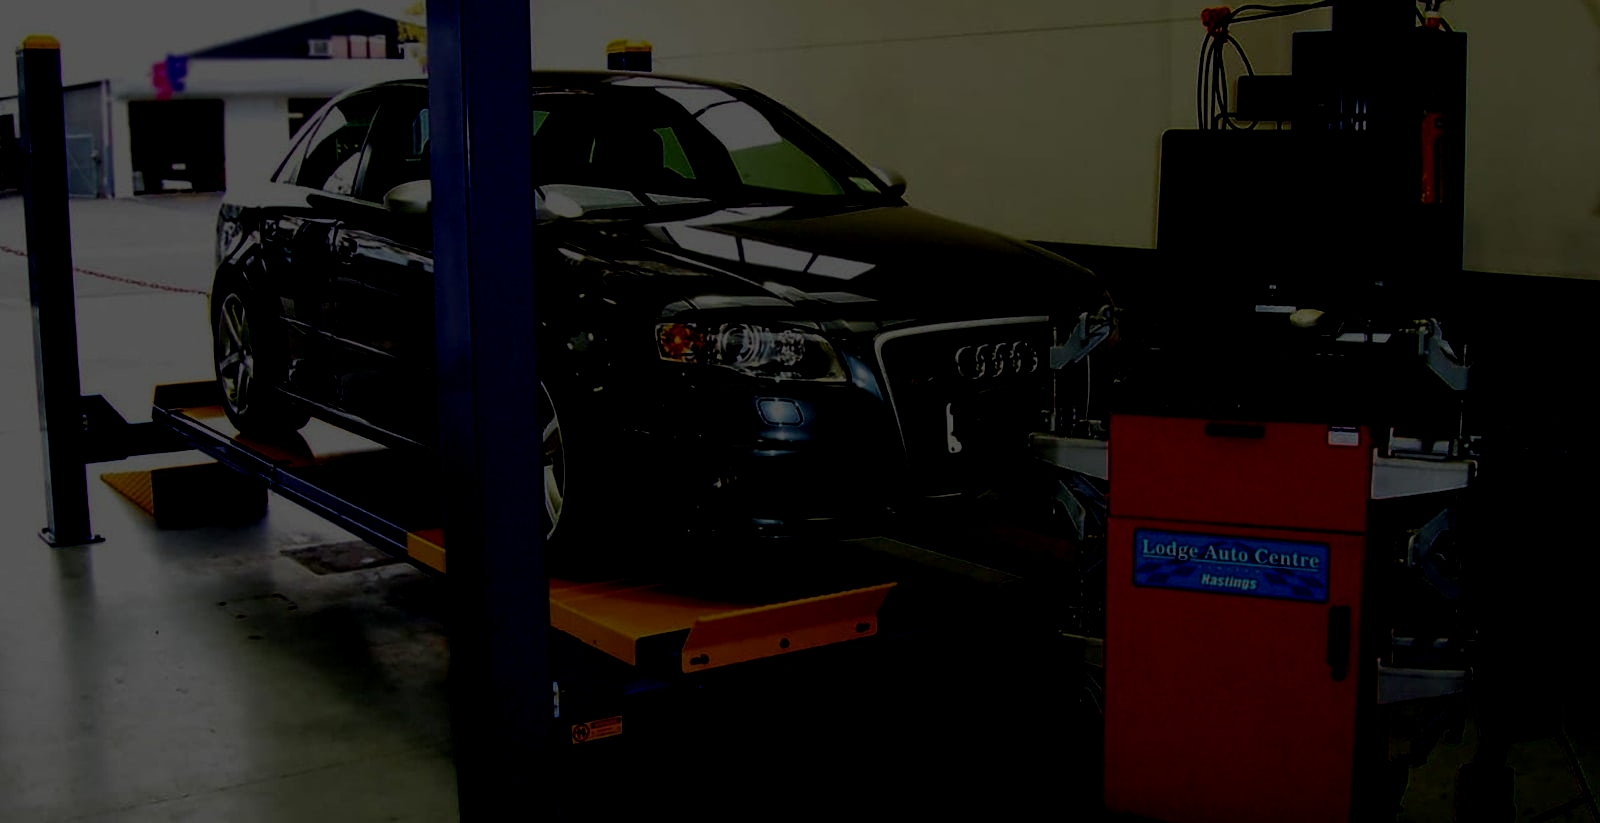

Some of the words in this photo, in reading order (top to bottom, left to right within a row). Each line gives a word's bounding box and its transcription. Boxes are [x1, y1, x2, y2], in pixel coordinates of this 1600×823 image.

[1143, 538, 1199, 561] Lodge
[1205, 545, 1249, 563] Auto
[1255, 548, 1320, 568] Centre
[1201, 573, 1258, 591] Hastings
